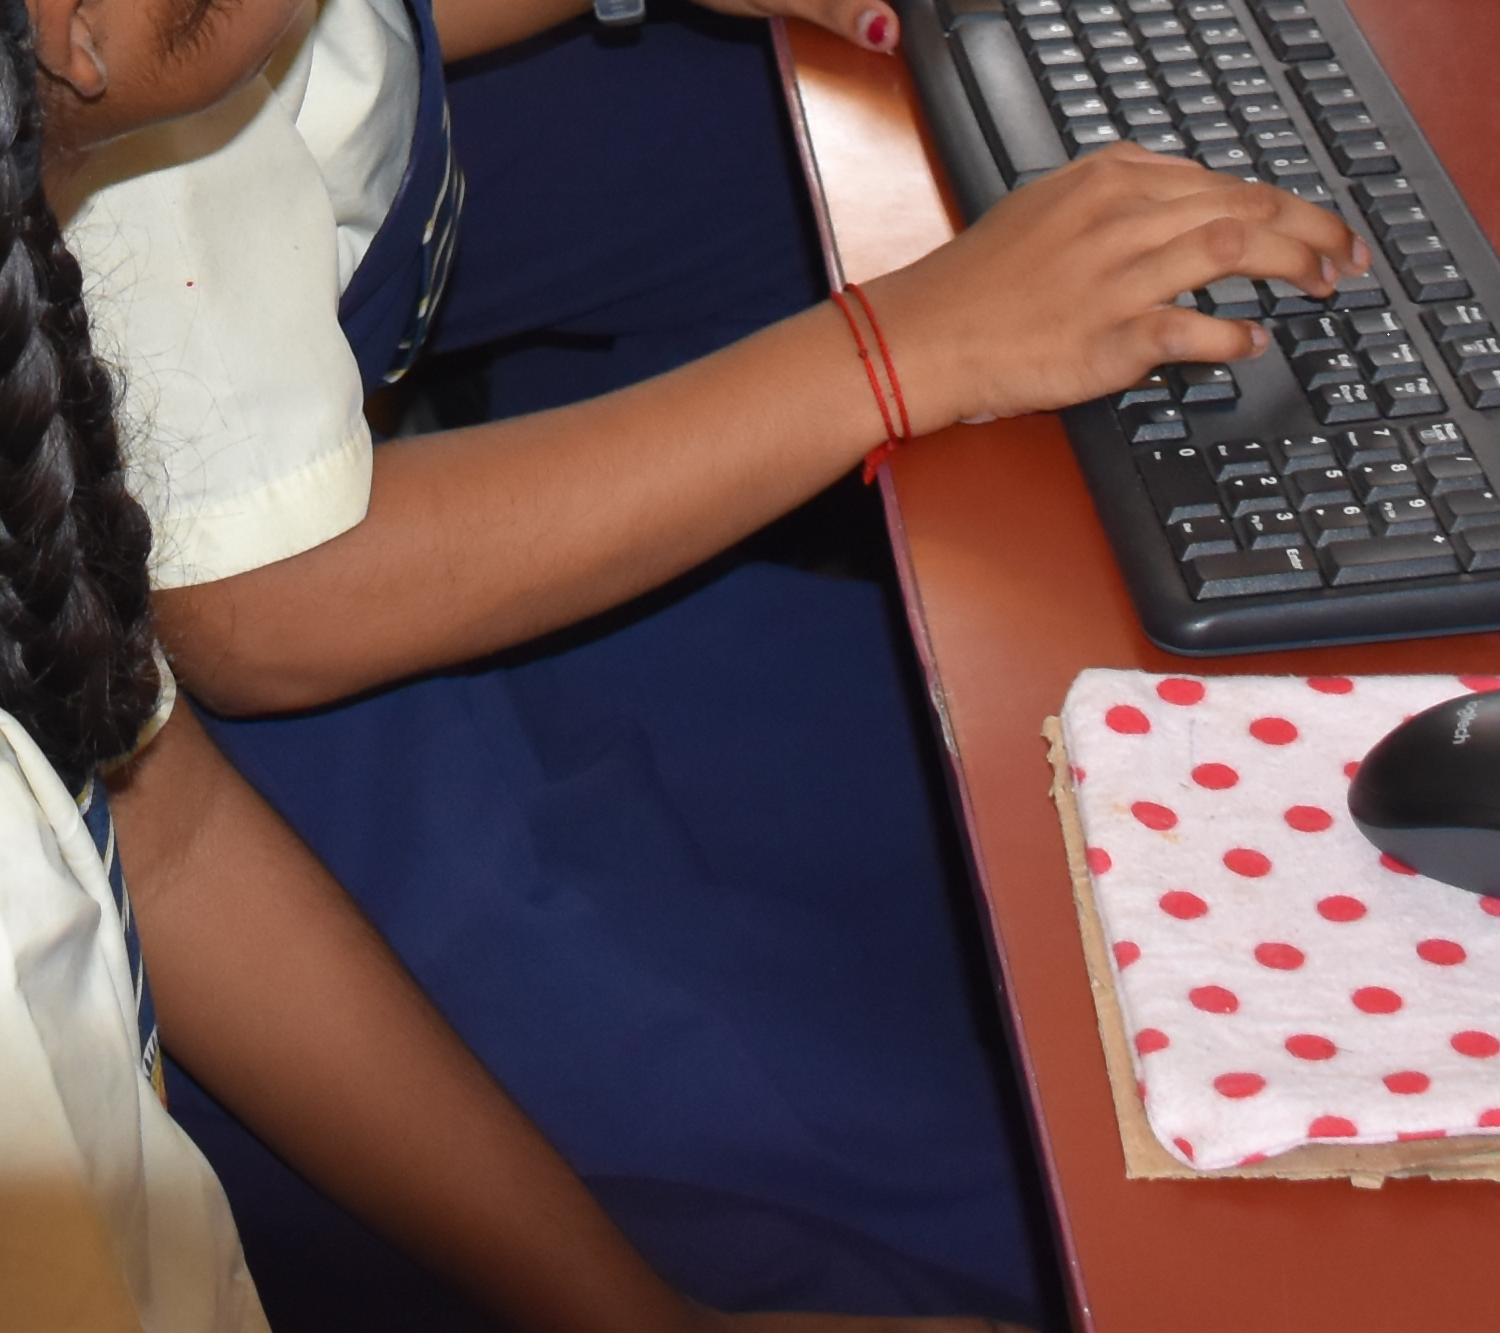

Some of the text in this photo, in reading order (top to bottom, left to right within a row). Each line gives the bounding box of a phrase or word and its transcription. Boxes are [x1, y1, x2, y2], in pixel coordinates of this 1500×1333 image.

[1373, 428, 1391, 436] 7
[1311, 436, 1327, 445] 4
[1178, 448, 1196, 457] 0
[1390, 463, 1408, 472] 8
[1325, 469, 1343, 478] 5
[1260, 476, 1278, 485] 2
[1409, 498, 1427, 508] 9
[1343, 506, 1361, 515] 6
[1276, 512, 1294, 521] 3
[1286, 548, 1303, 570] Enter
